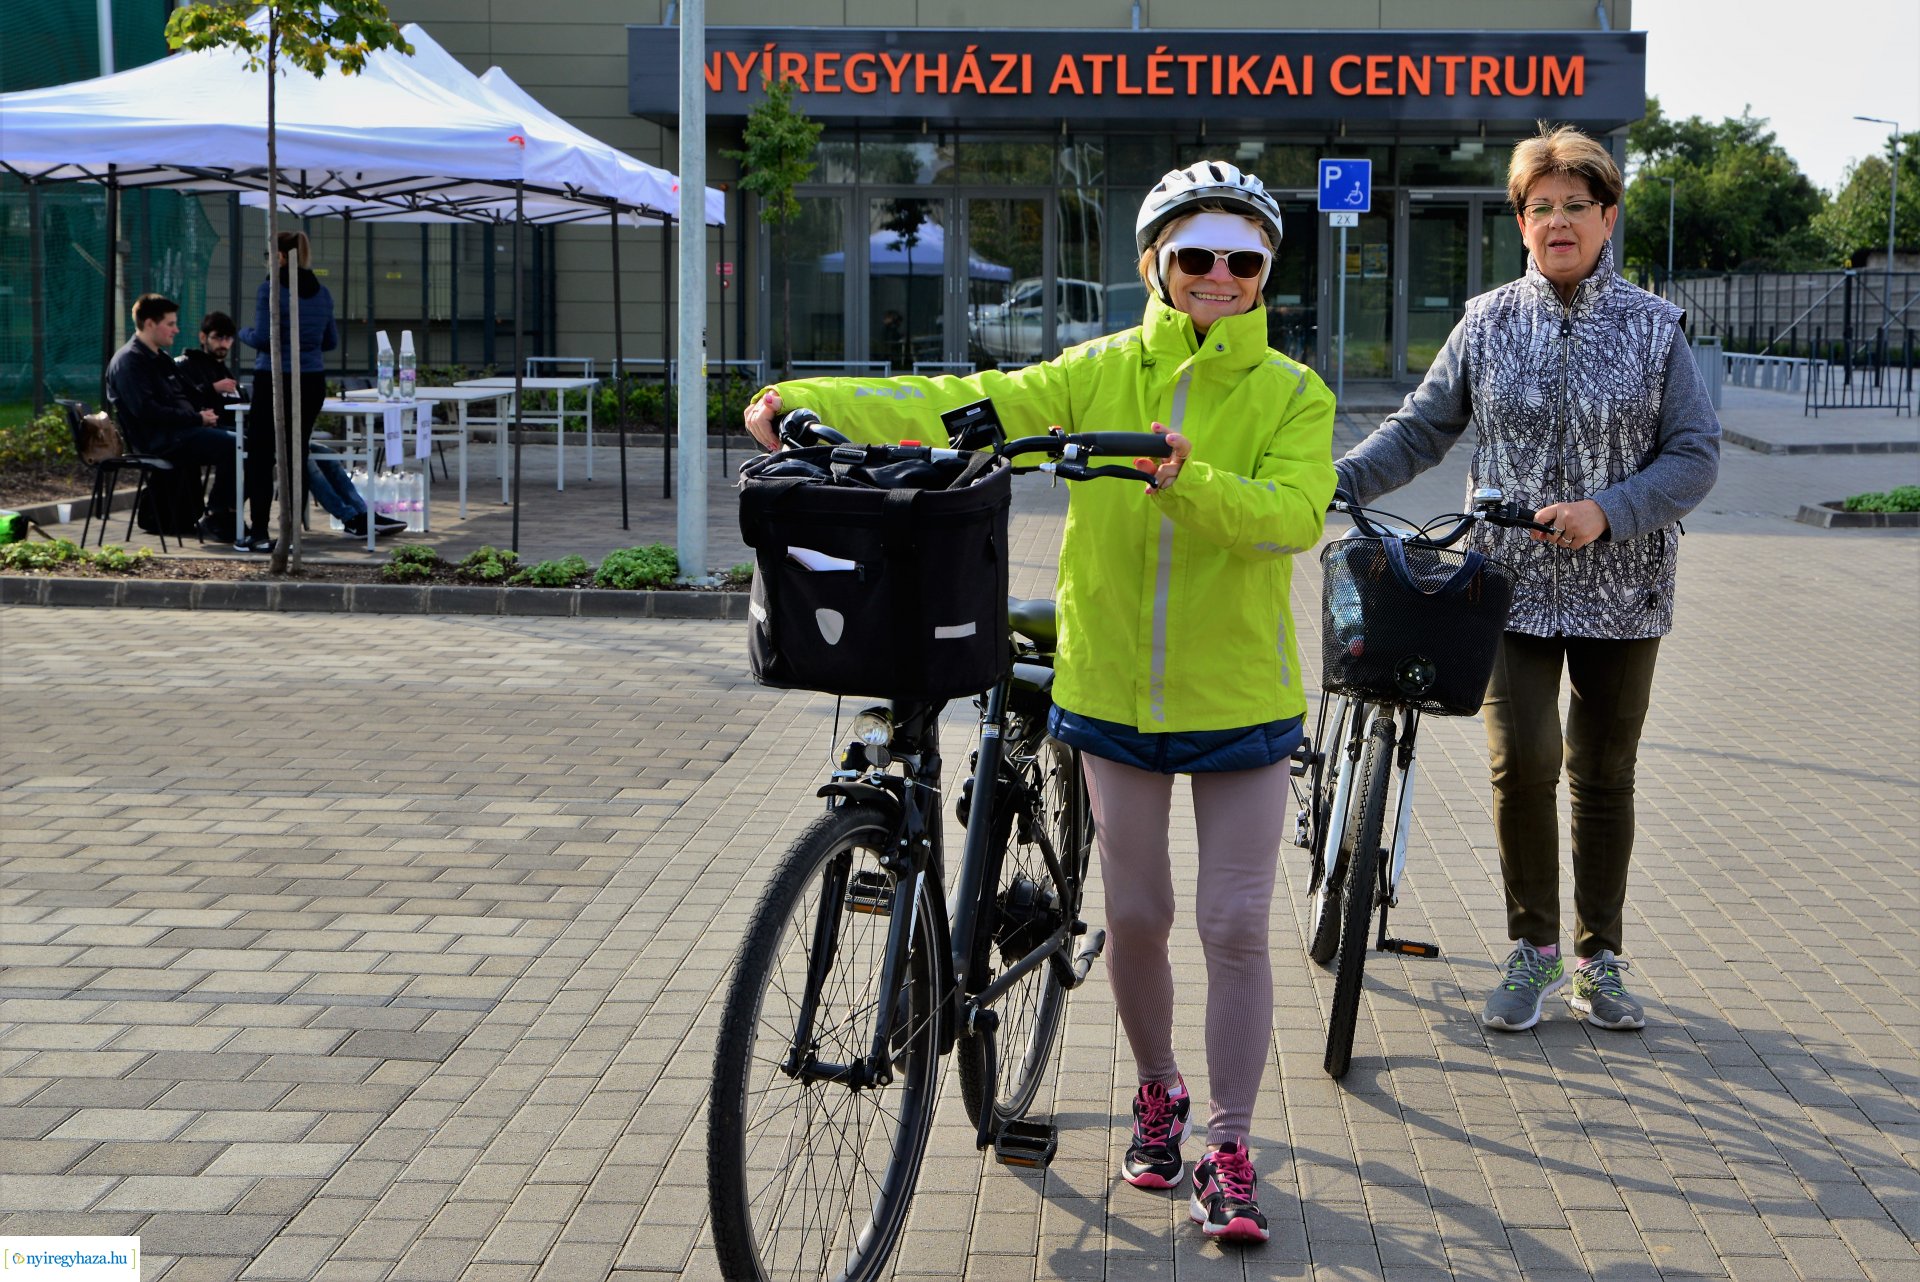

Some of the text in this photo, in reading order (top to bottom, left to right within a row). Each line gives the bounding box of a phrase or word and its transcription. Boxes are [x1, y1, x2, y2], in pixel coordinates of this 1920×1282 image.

[1049, 46, 1313, 95] ATLÉTIKAI
[1330, 54, 1584, 96] CENTRUM
[1325, 165, 1342, 189] P
[1336, 214, 1352, 225] 2X
